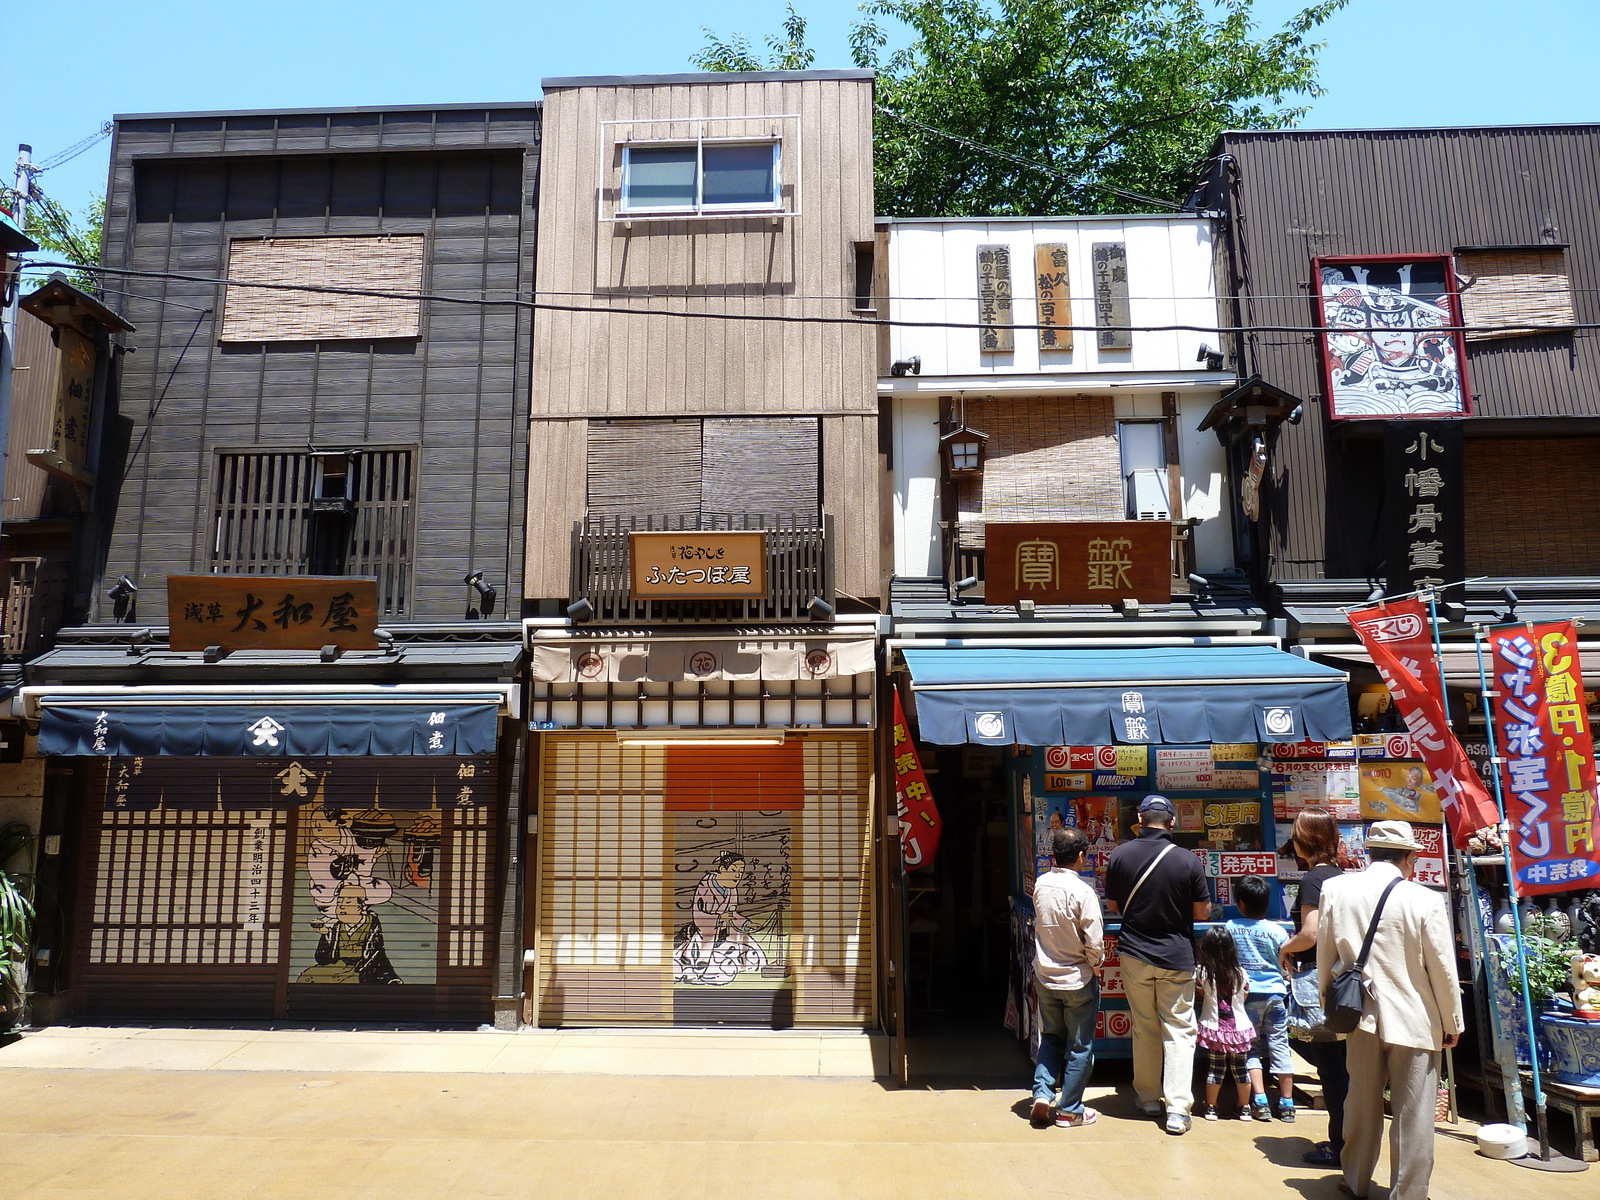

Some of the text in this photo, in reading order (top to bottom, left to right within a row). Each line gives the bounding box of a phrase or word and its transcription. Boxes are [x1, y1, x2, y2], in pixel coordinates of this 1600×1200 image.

[1051, 248, 1068, 287] 富久
[1404, 431, 1446, 604] 小幡骨董店
[646, 565, 752, 585] ふたつぼ屋
[184, 591, 359, 633] 浅草 大和屋
[92, 711, 109, 751] 大和屋
[427, 712, 447, 750] 佃煮
[1071, 752, 1094, 762] 宝くじ
[1298, 745, 1324, 754] 宝くじ
[115, 763, 130, 807] 大和屋
[456, 762, 475, 806] 佃煮
[1051, 776, 1072, 788] LOTO
[1096, 774, 1137, 785] NUMBERS
[1204, 803, 1260, 826] 3億円
[248, 827, 267, 924] 創業明治四十三年
[1209, 852, 1274, 876] 宝くじ 発売中
[1217, 878, 1228, 902] 発売中
[1254, 930, 1278, 940] LAND
